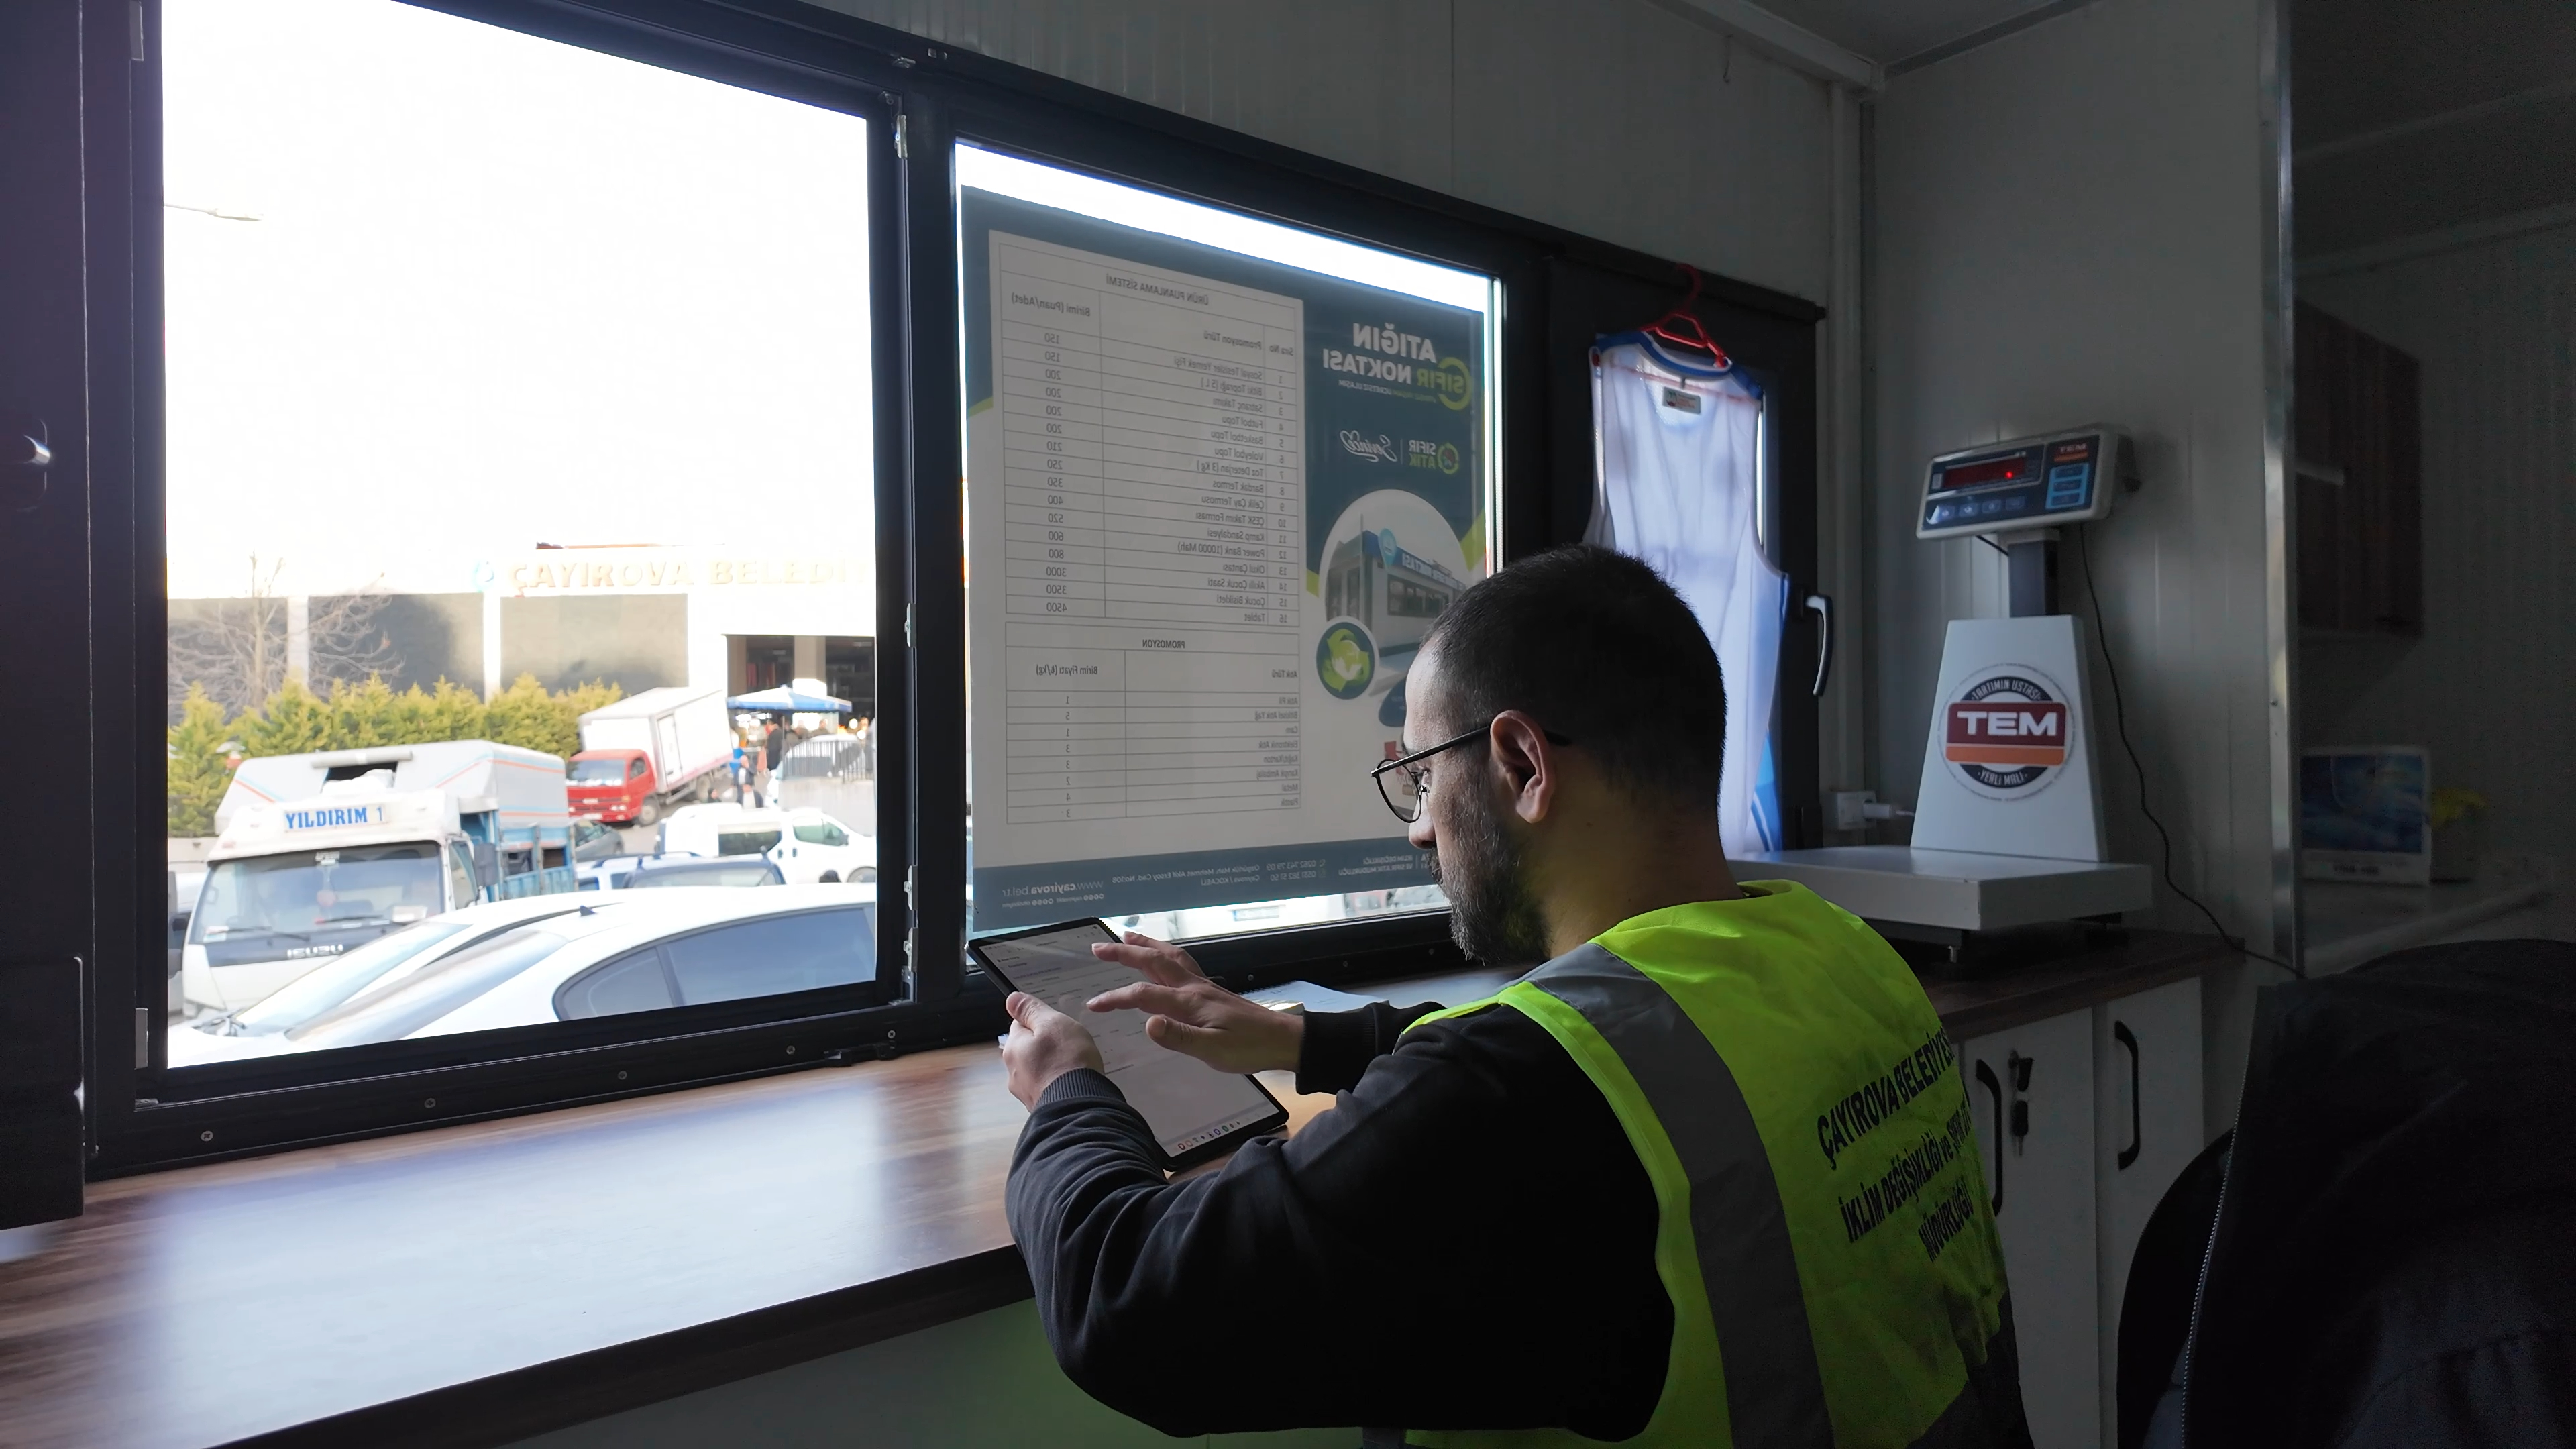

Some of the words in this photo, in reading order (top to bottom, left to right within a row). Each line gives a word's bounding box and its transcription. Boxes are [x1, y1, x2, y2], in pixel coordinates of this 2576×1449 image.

[2059, 443, 2087, 453] TEM
[508, 561, 694, 597] ÇAYIROVA
[1972, 679, 2010, 700] TARTIMIN
[2011, 680, 2040, 700] USTASI
[1957, 711, 2057, 736] TEM
[286, 807, 368, 829] YILDIRIM
[376, 807, 382, 822] 1
[1817, 1075, 1900, 1170] ÇAYIROVA
[1839, 1182, 1886, 1243] İKLİM
[1880, 1128, 1943, 1214] DEĞİŞİKLİĞİ
[1939, 1135, 1953, 1163] ve
